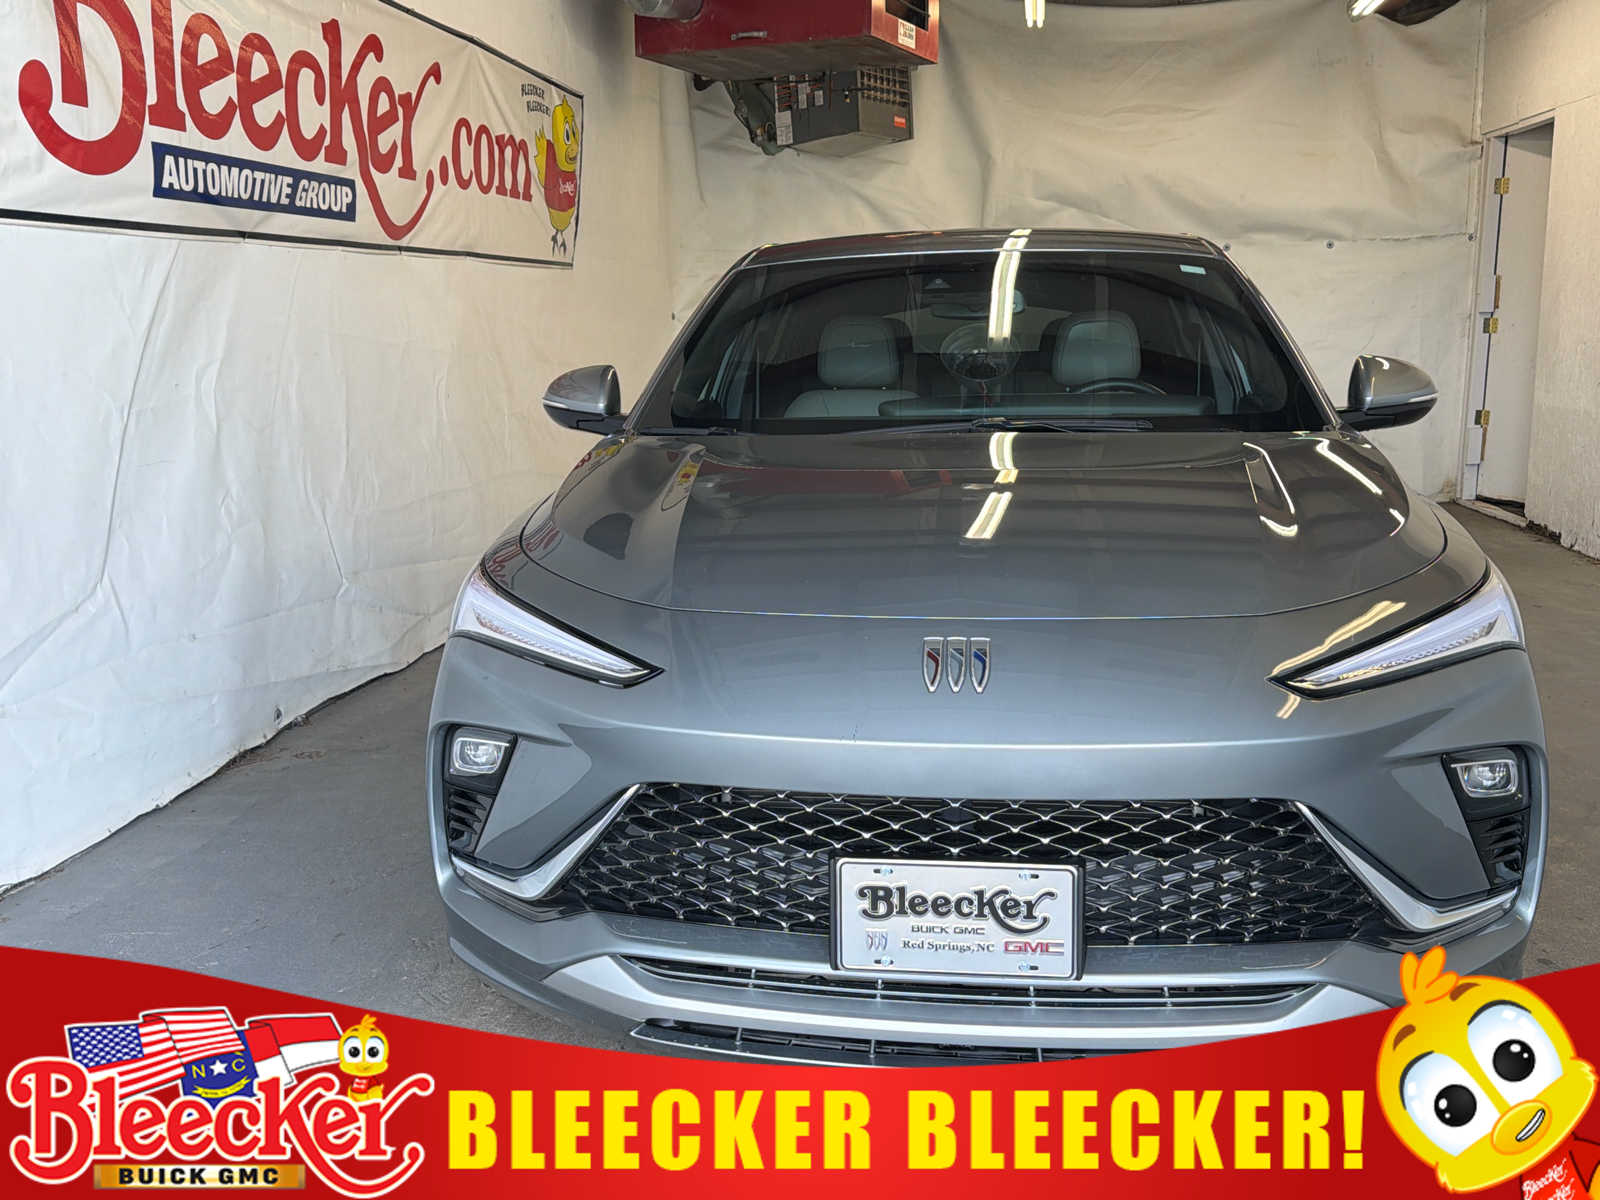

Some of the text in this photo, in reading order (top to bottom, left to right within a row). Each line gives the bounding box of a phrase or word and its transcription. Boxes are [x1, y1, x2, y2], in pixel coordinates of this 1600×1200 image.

[162, 154, 353, 214] AUTOMOTIVE GROUP
[858, 884, 1057, 934] Bleecker
[911, 925, 985, 935] BUICK GMC
[902, 939, 925, 949] Red
[1004, 941, 1064, 955] GMC
